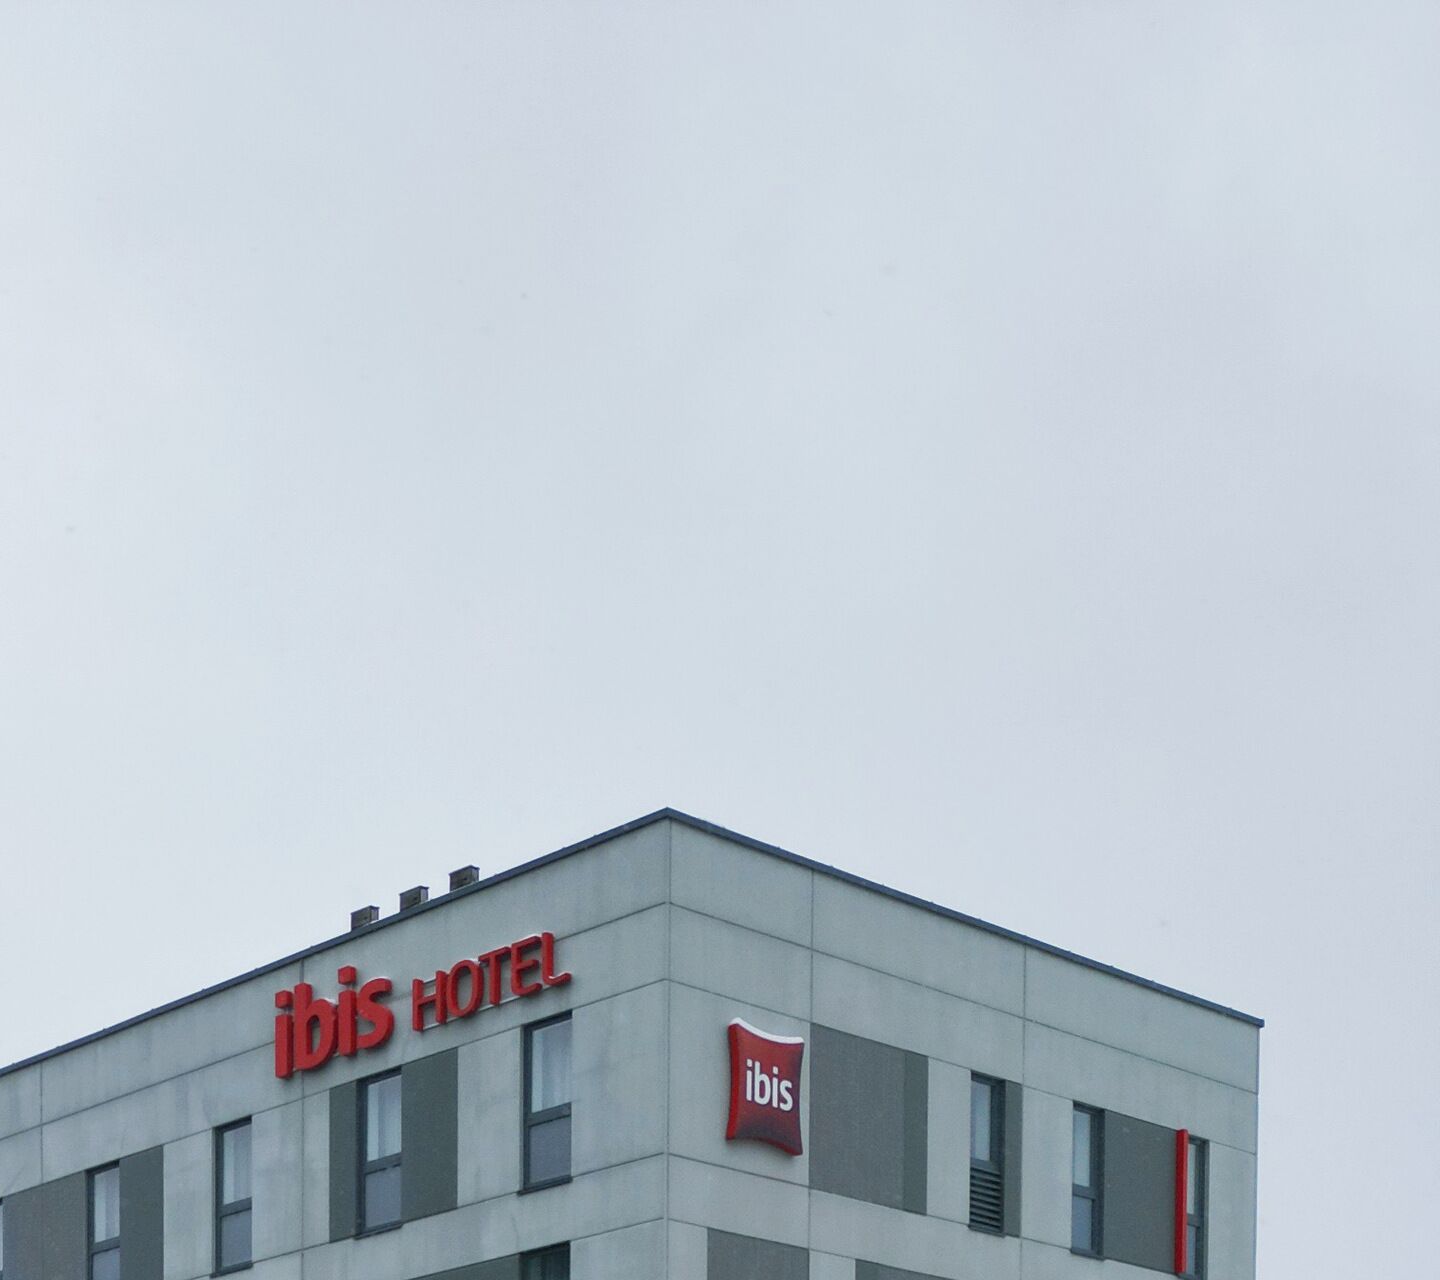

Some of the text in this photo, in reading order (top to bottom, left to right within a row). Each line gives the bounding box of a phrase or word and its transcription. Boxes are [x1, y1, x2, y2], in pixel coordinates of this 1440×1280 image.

[274, 931, 573, 1079] ibis HOTEL
[745, 1058, 794, 1112] ibis
